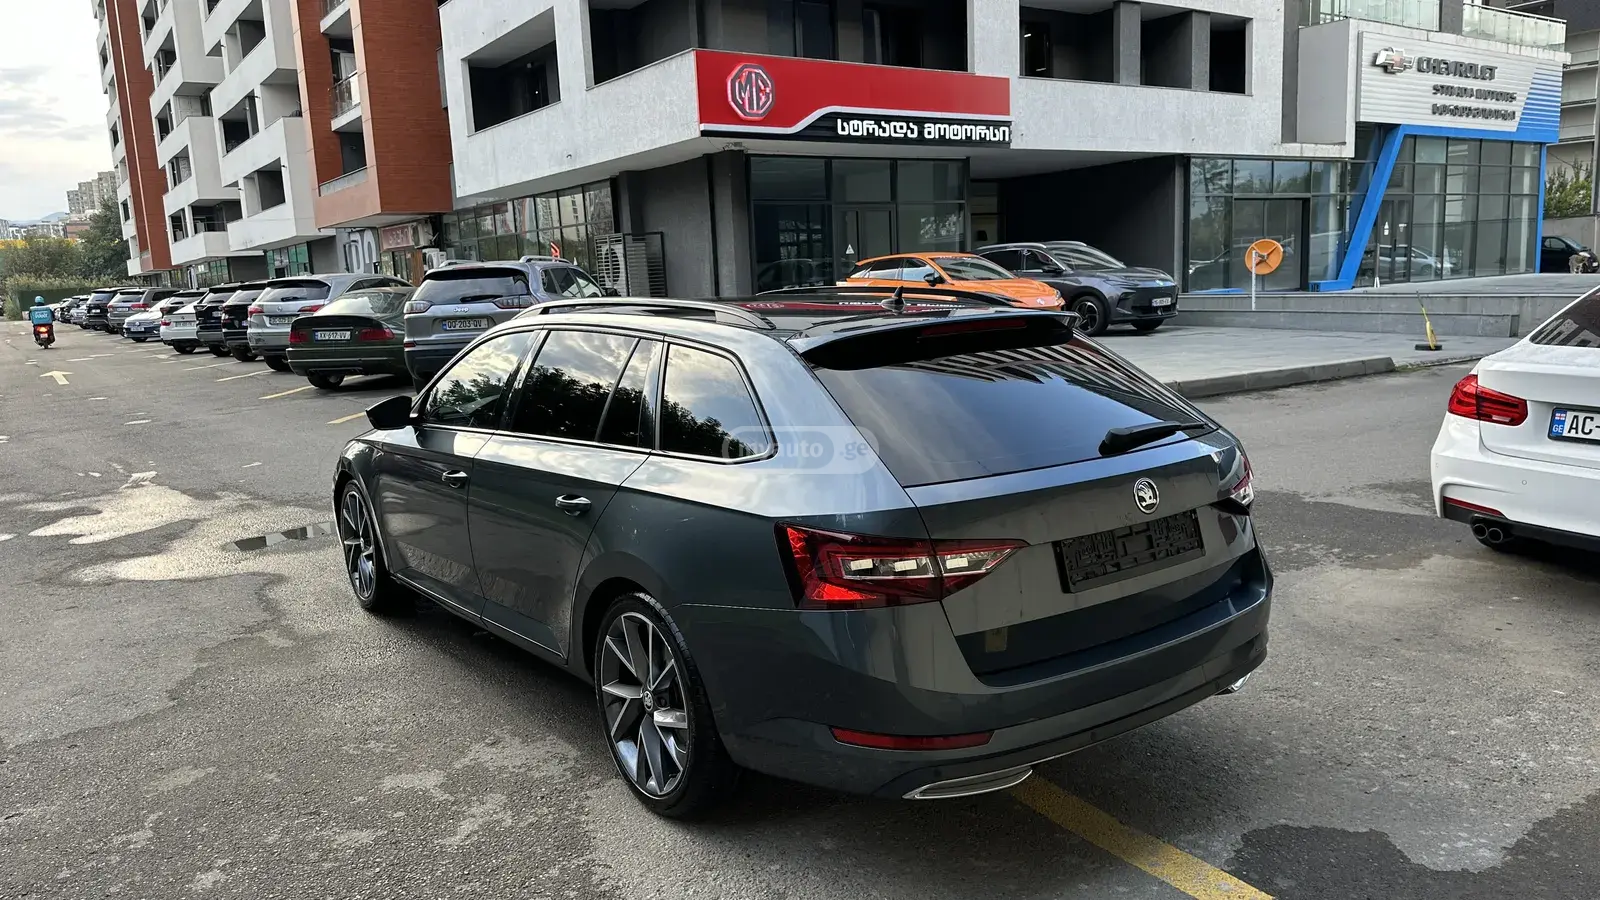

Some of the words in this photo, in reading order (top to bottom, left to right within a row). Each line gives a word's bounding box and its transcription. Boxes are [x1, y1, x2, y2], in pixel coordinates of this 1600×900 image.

[1416, 56, 1498, 81] CHEVROLET
[732, 67, 774, 116] MG
[836, 118, 918, 138] სტრადა
[923, 122, 1010, 141] მოტორსი
[1552, 424, 1564, 433] GE
